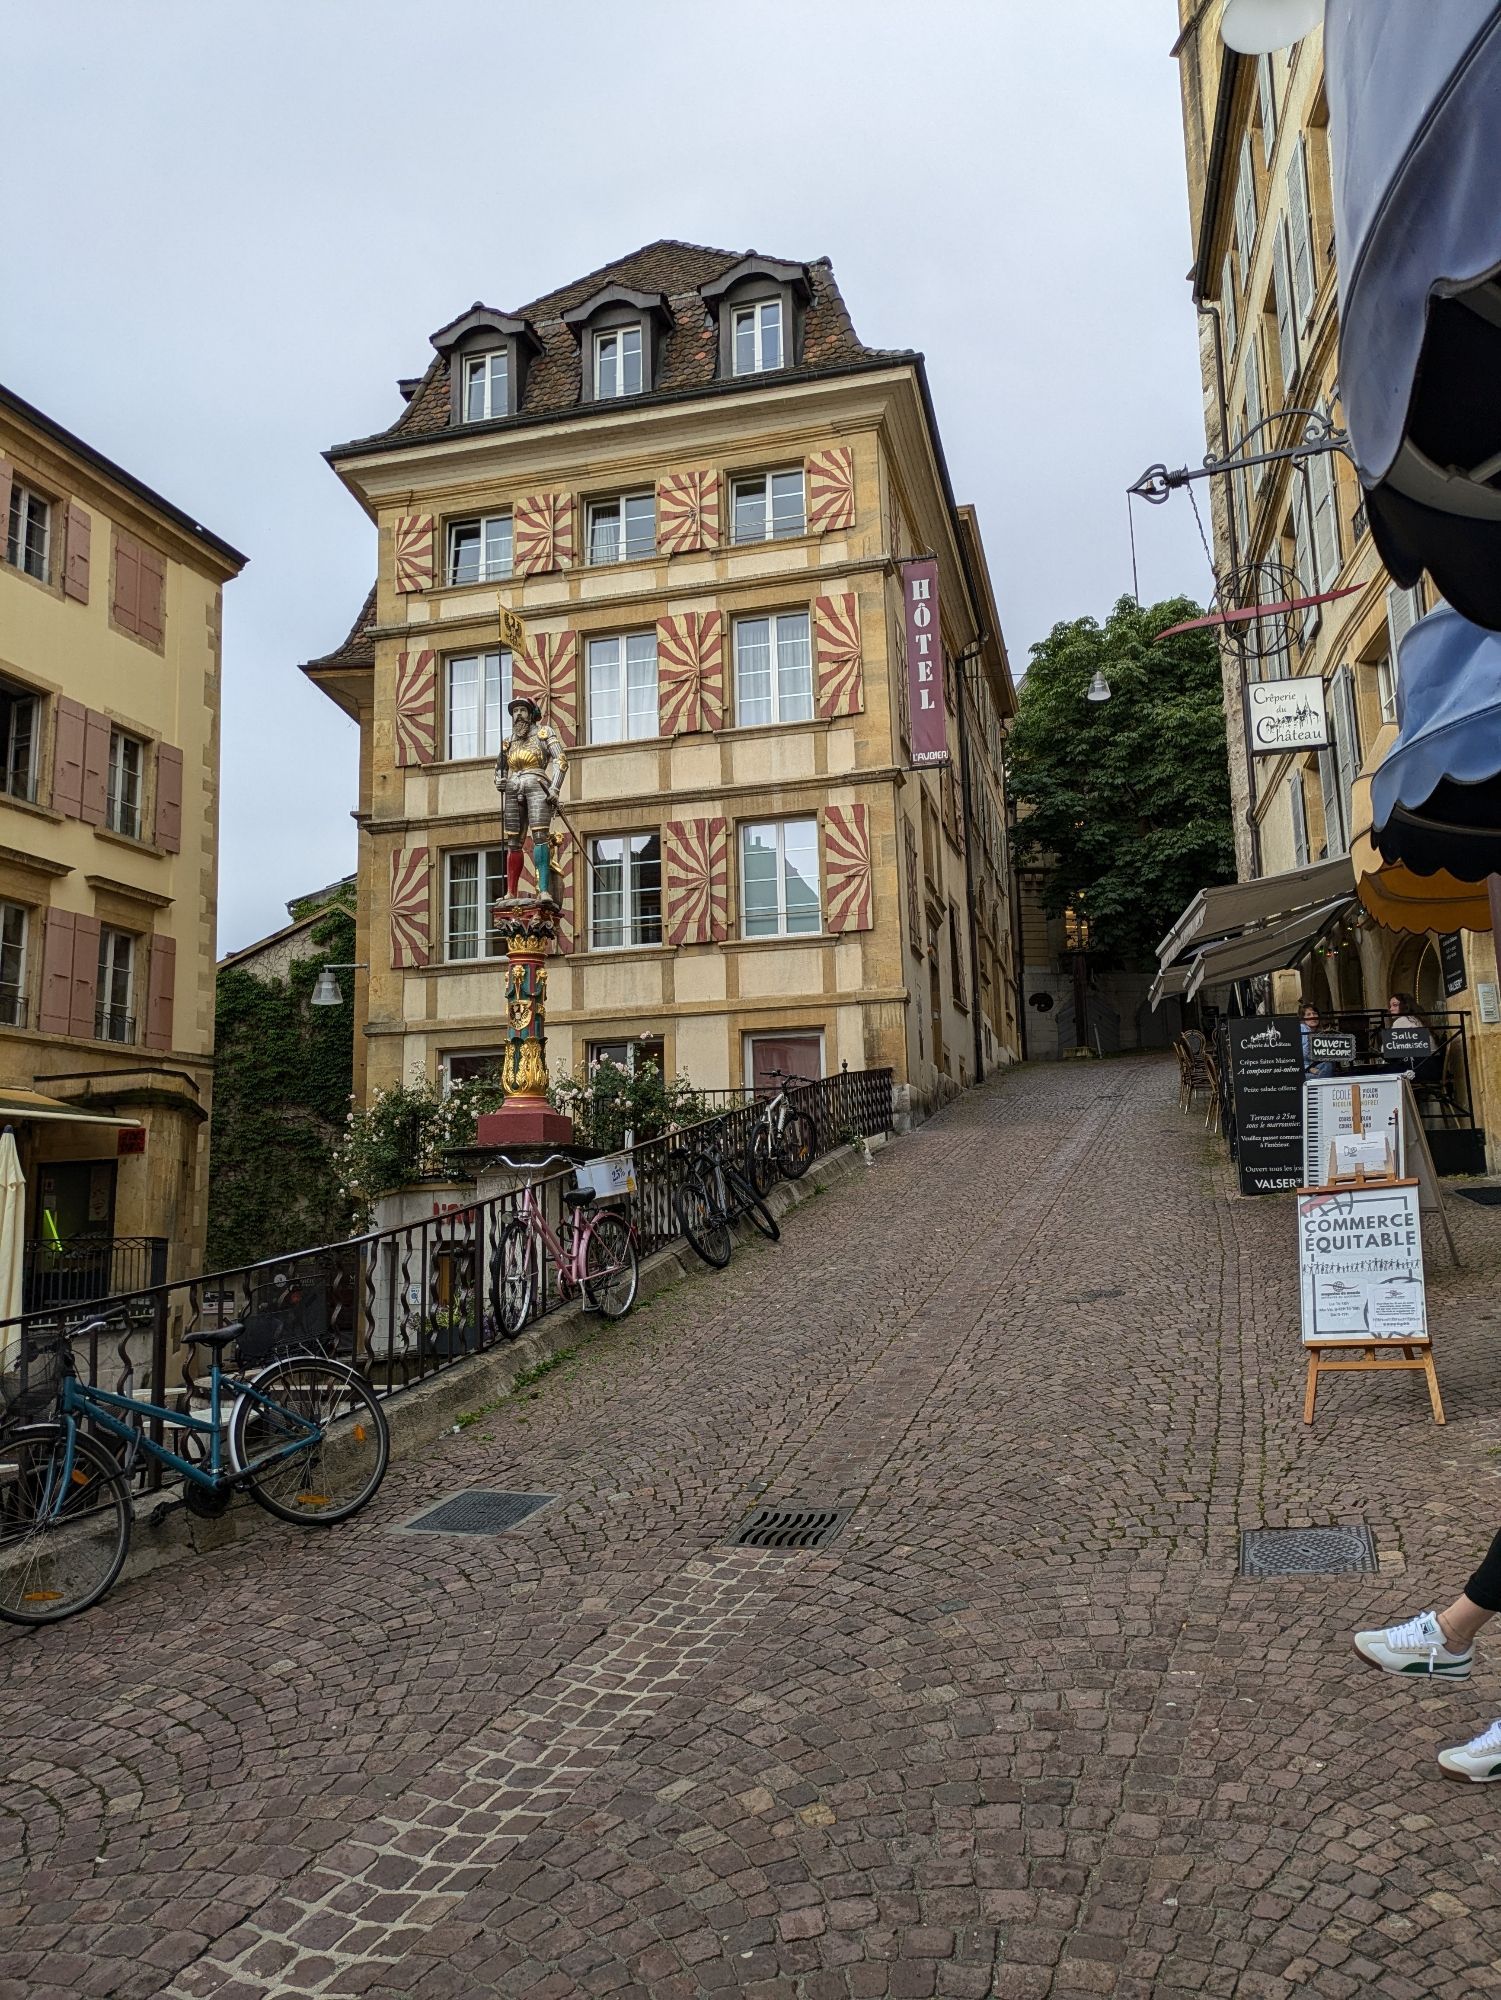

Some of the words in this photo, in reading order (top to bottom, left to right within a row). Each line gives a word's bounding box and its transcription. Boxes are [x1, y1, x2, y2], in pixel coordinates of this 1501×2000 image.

[912, 578, 935, 710] HÔTEL
[1254, 687, 1296, 704] Crêperie
[1276, 705, 1287, 713] du
[1257, 716, 1322, 743] Château
[1313, 1038, 1351, 1048] Ouvert
[1391, 1031, 1419, 1040] Salle
[1255, 1178, 1297, 1188] VALSER
[1304, 1212, 1414, 1234] COMMERCE
[1305, 1230, 1416, 1254] ÉQUITABLE
